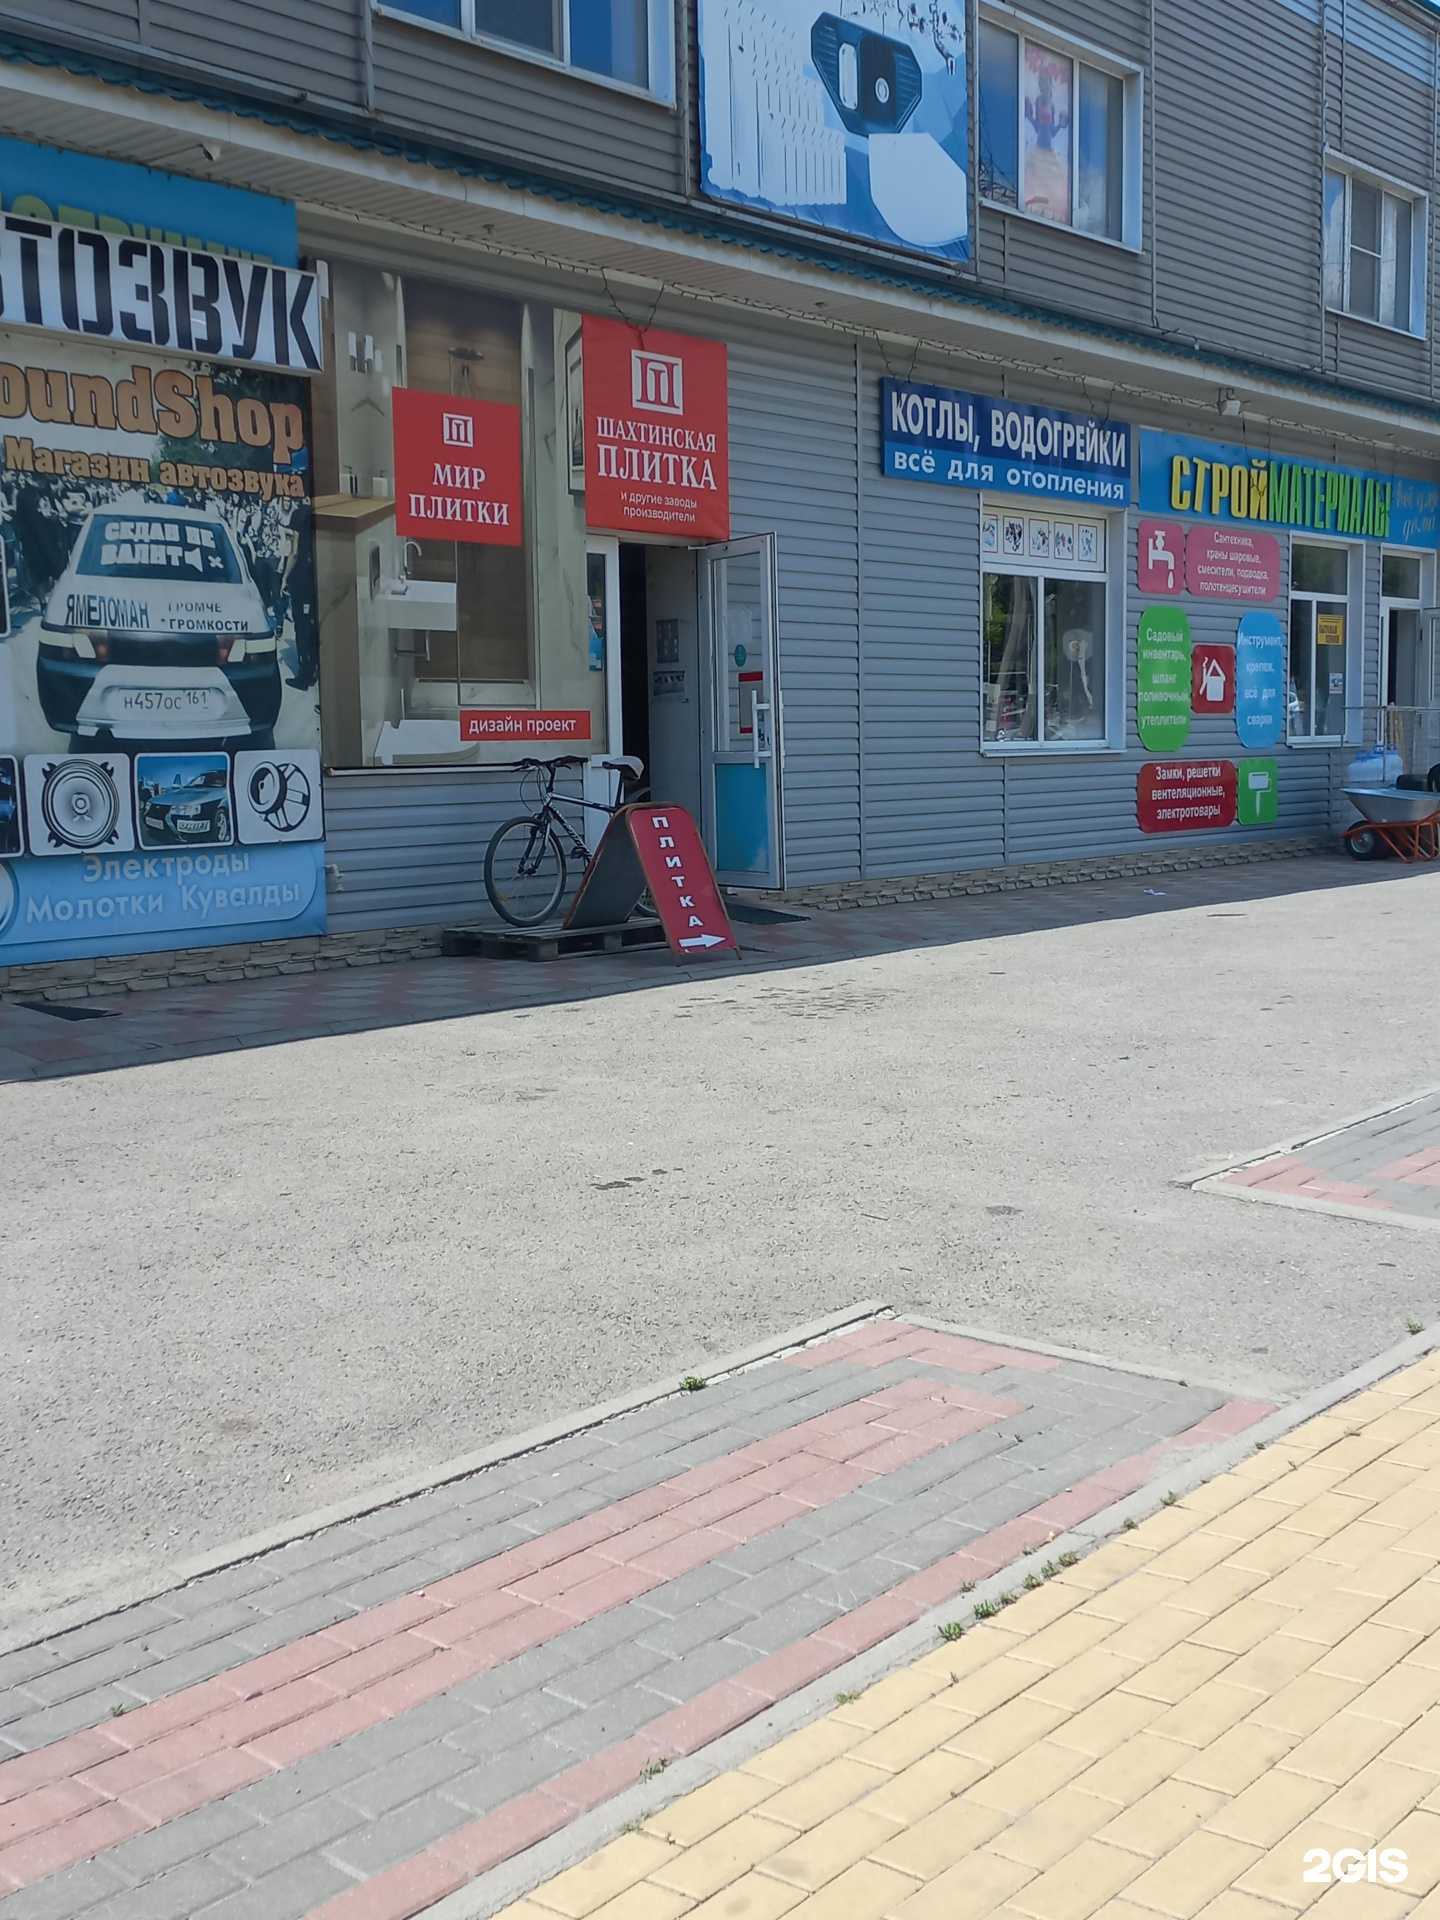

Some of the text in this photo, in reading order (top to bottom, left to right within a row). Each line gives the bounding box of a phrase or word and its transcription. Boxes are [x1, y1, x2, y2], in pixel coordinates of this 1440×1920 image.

[0, 215, 321, 369] ТОЗВУК
[596, 416, 716, 453] ШАХТИНСКАЯ
[891, 391, 1126, 468] КОТЛЫ, ВОДОГРЕЙКИ
[3, 435, 305, 500] Магазин автозвука
[432, 463, 486, 490] МИР
[597, 444, 718, 490] ПЛИТКА
[894, 449, 1125, 500] всё для отопления
[408, 493, 510, 526] ПЛИТКИ
[629, 492, 663, 505] другие
[664, 496, 697, 510] заводы
[1171, 455, 1393, 538] СТРОЙМАТЕРИАЛЫ
[623, 506, 696, 523] производители
[168, 617, 249, 632] ГРОМКОСТИ
[469, 715, 577, 735] дизайн проект
[1155, 766, 1221, 782] Замки, решетки
[1156, 804, 1221, 822] электротовары
[81, 852, 250, 885] Электроды
[651, 815, 704, 928] ПЛИТКА
[26, 883, 300, 924] Молотки Кувалды
